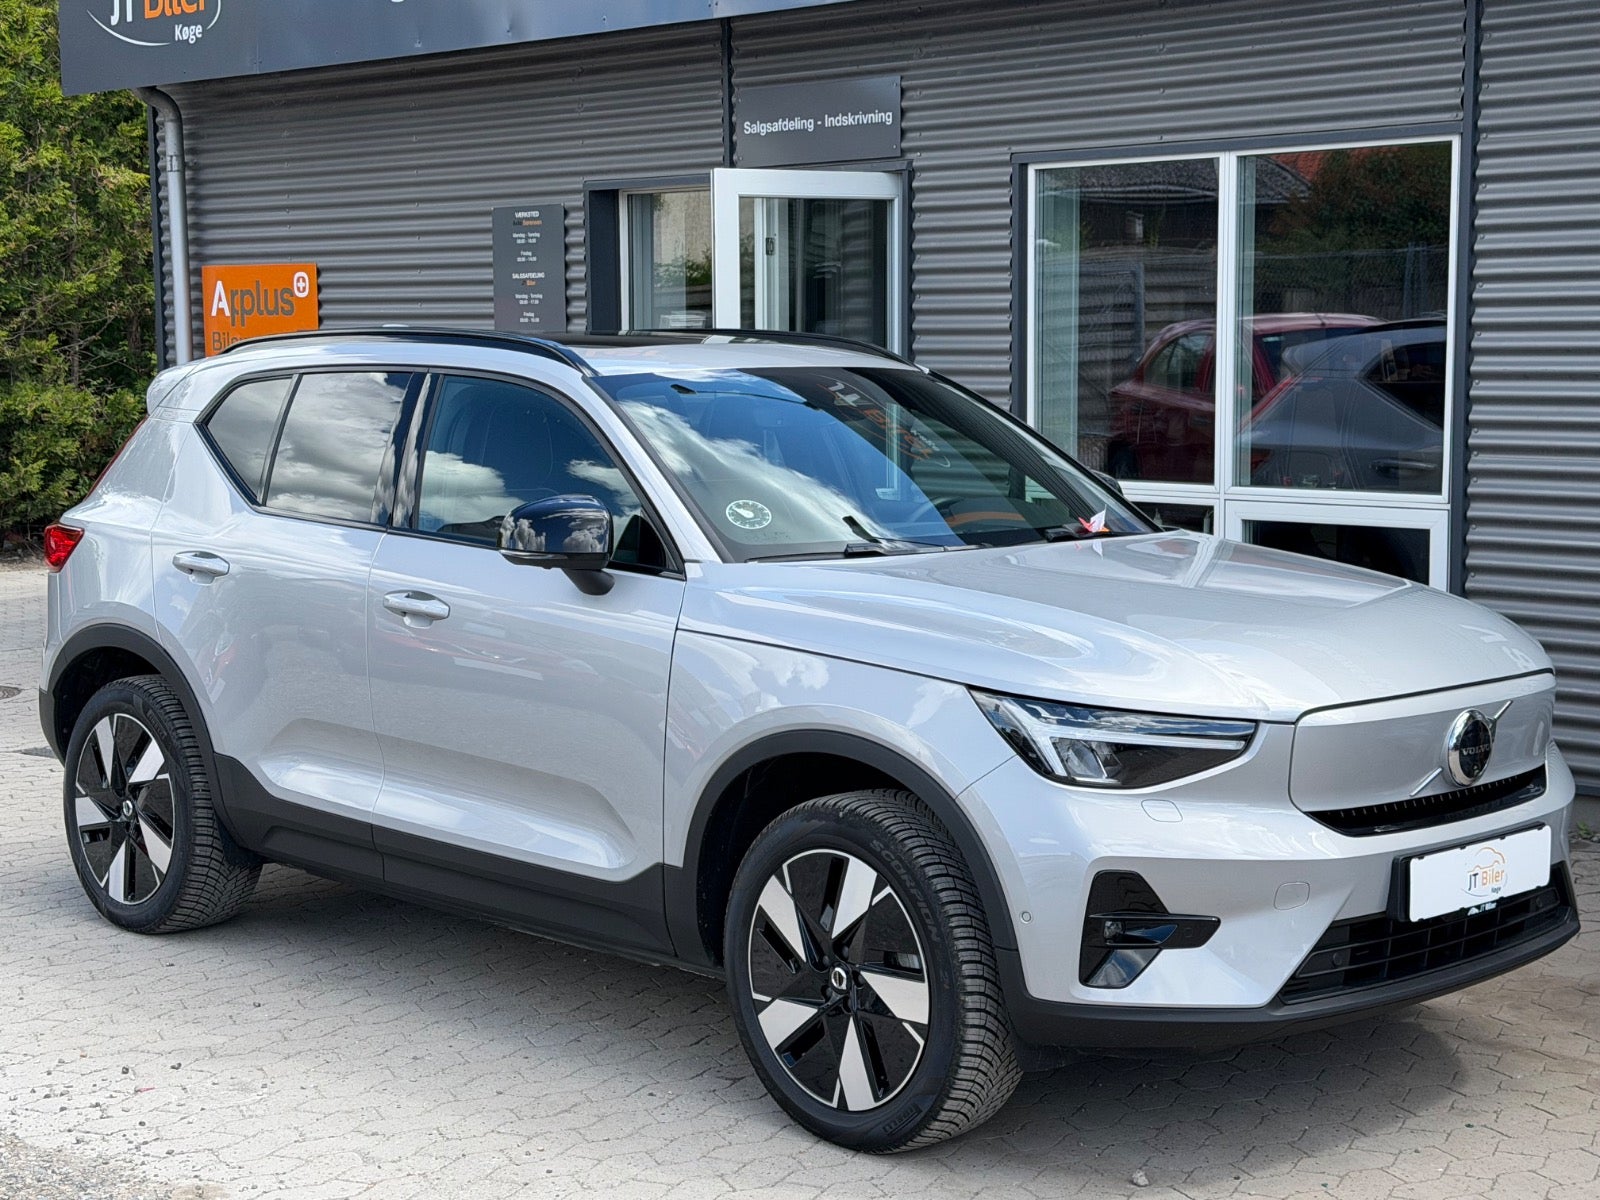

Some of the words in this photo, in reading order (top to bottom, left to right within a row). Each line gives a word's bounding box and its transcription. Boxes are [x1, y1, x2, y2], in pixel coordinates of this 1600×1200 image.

[174, 24, 203, 44] Køge
[743, 117, 815, 136] Salgsafdeling
[824, 109, 893, 128] Indskrivning
[1461, 744, 1490, 756] VOLVO
[1468, 872, 1480, 891] JT
[1481, 868, 1505, 887] Biler
